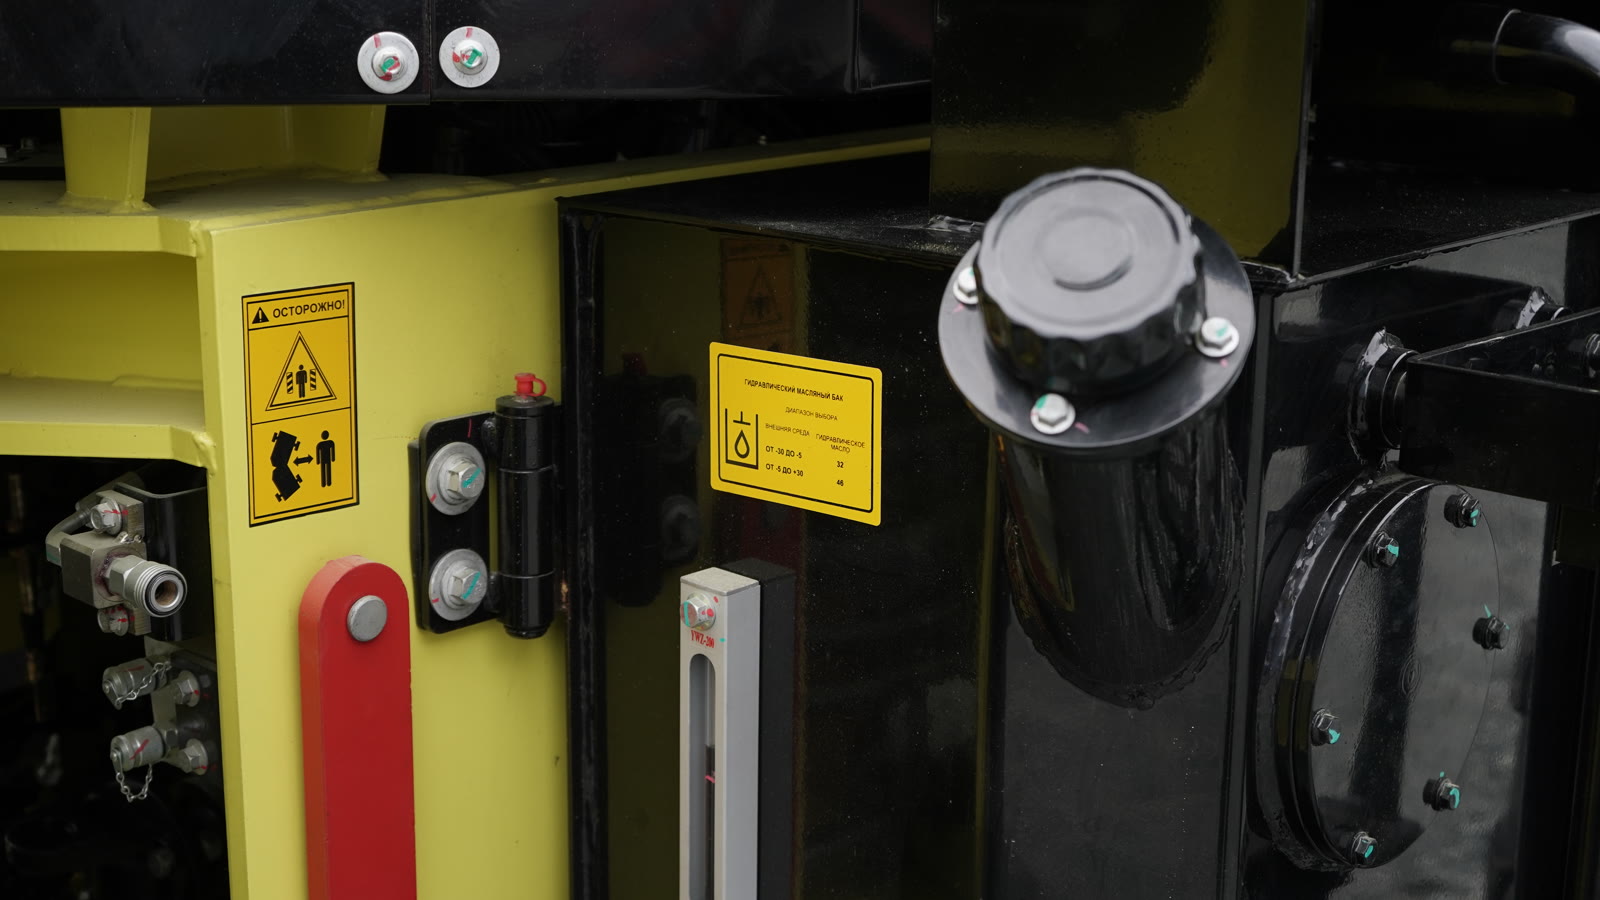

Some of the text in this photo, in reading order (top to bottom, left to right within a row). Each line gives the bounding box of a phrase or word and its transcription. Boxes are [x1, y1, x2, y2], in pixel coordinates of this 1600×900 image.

[273, 300, 345, 318] ОСТОРОЖНО!
[744, 378, 844, 402] ГИДРАВЛИЧЕСКИЙ МАСЛЯНЫЙ БАК
[785, 406, 838, 421] ДИАПАЗОН ВЫБОРА
[765, 423, 810, 437] ВНЕШНЯЯ СРЕДА
[815, 433, 866, 448] ГИДРАВЛИЧЕСКОЕ
[785, 449, 795, 458] ДО
[830, 444, 851, 454] МАСЛО
[775, 465, 782, 473] -5
[782, 466, 792, 475] ДО
[793, 469, 804, 477] +30
